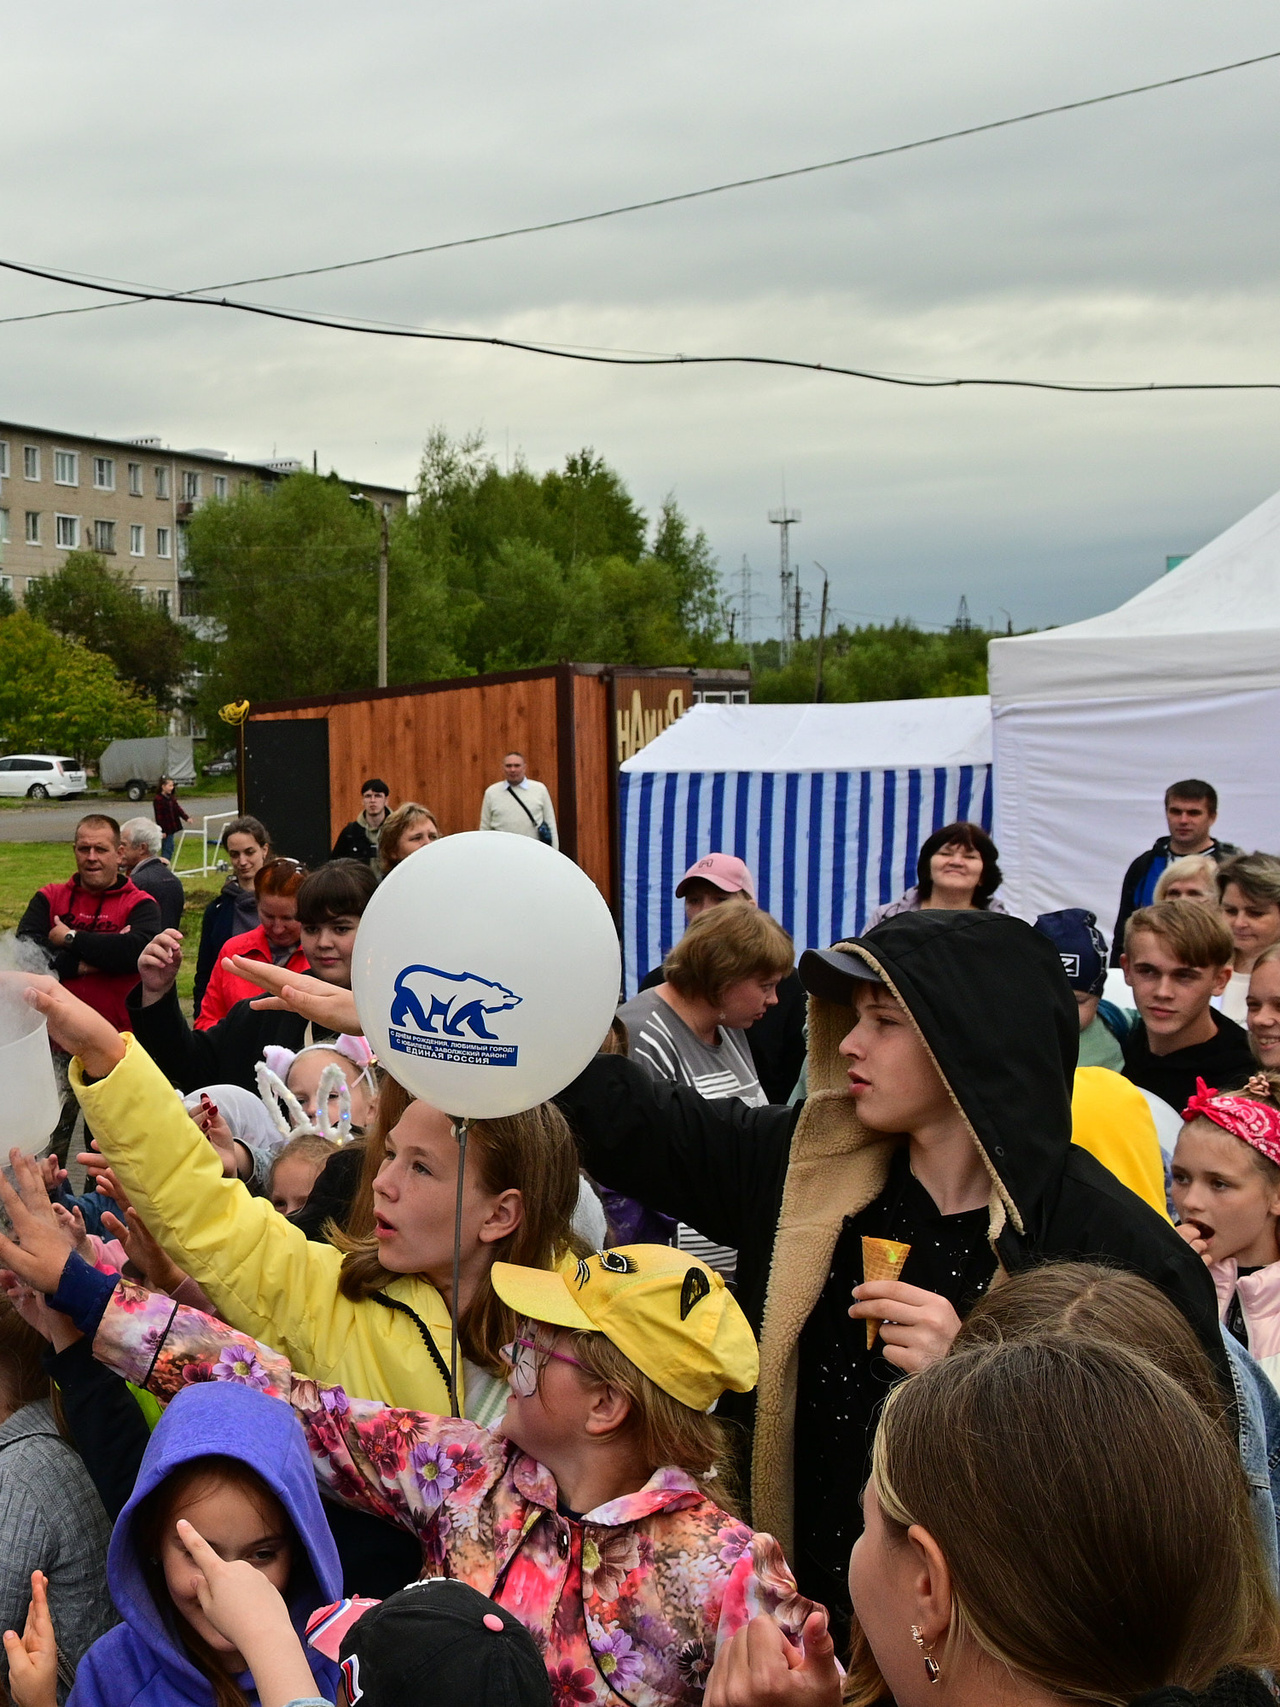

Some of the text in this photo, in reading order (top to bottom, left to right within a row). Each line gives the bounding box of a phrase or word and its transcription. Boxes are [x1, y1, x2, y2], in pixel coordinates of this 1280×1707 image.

[450, 1042, 488, 1051] ЛЮБИМЫЙ
[405, 1046, 490, 1065] ЕДИНАЯ РОССИЯ
[481, 1051, 507, 1059] РАЙОН!
